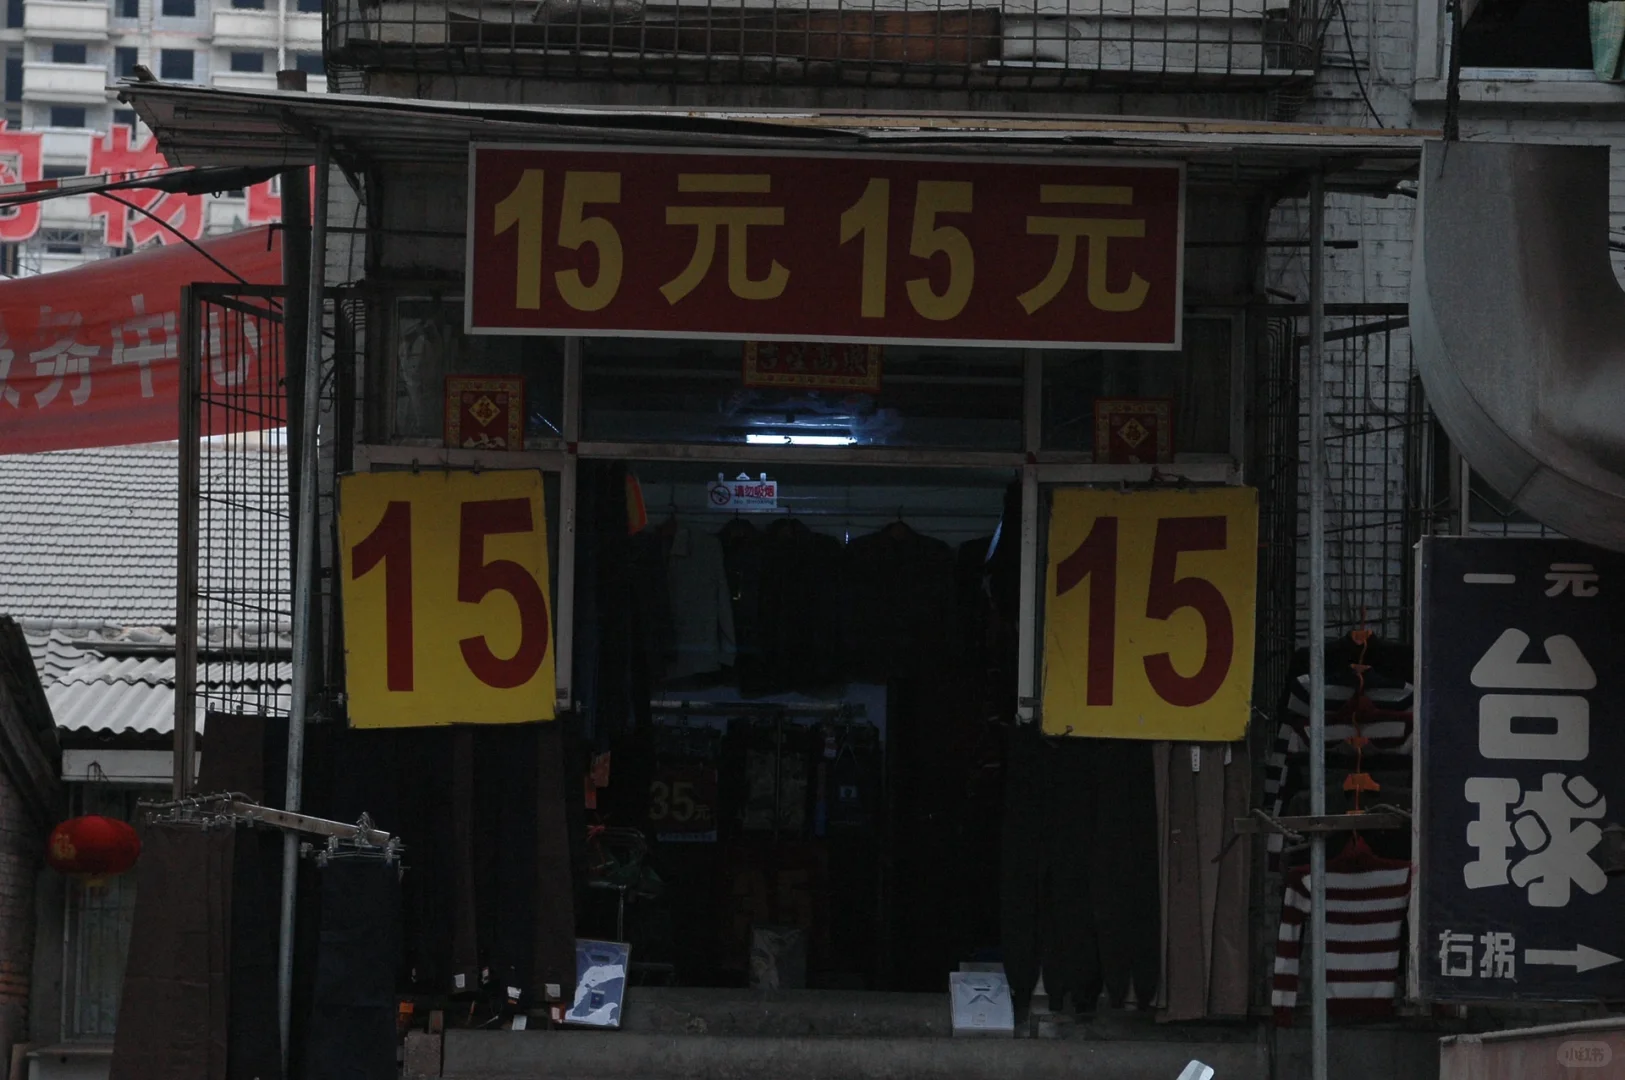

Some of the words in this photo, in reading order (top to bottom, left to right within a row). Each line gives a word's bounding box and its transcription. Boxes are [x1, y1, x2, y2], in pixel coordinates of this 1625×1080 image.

[0, 294, 263, 408] 务中心
[734, 484, 775, 498] 请勿吸烟
[352, 497, 548, 689] 15
[1056, 515, 1234, 707] 15
[1463, 627, 1608, 908] 台球
[1438, 929, 1516, 979] 右拐
